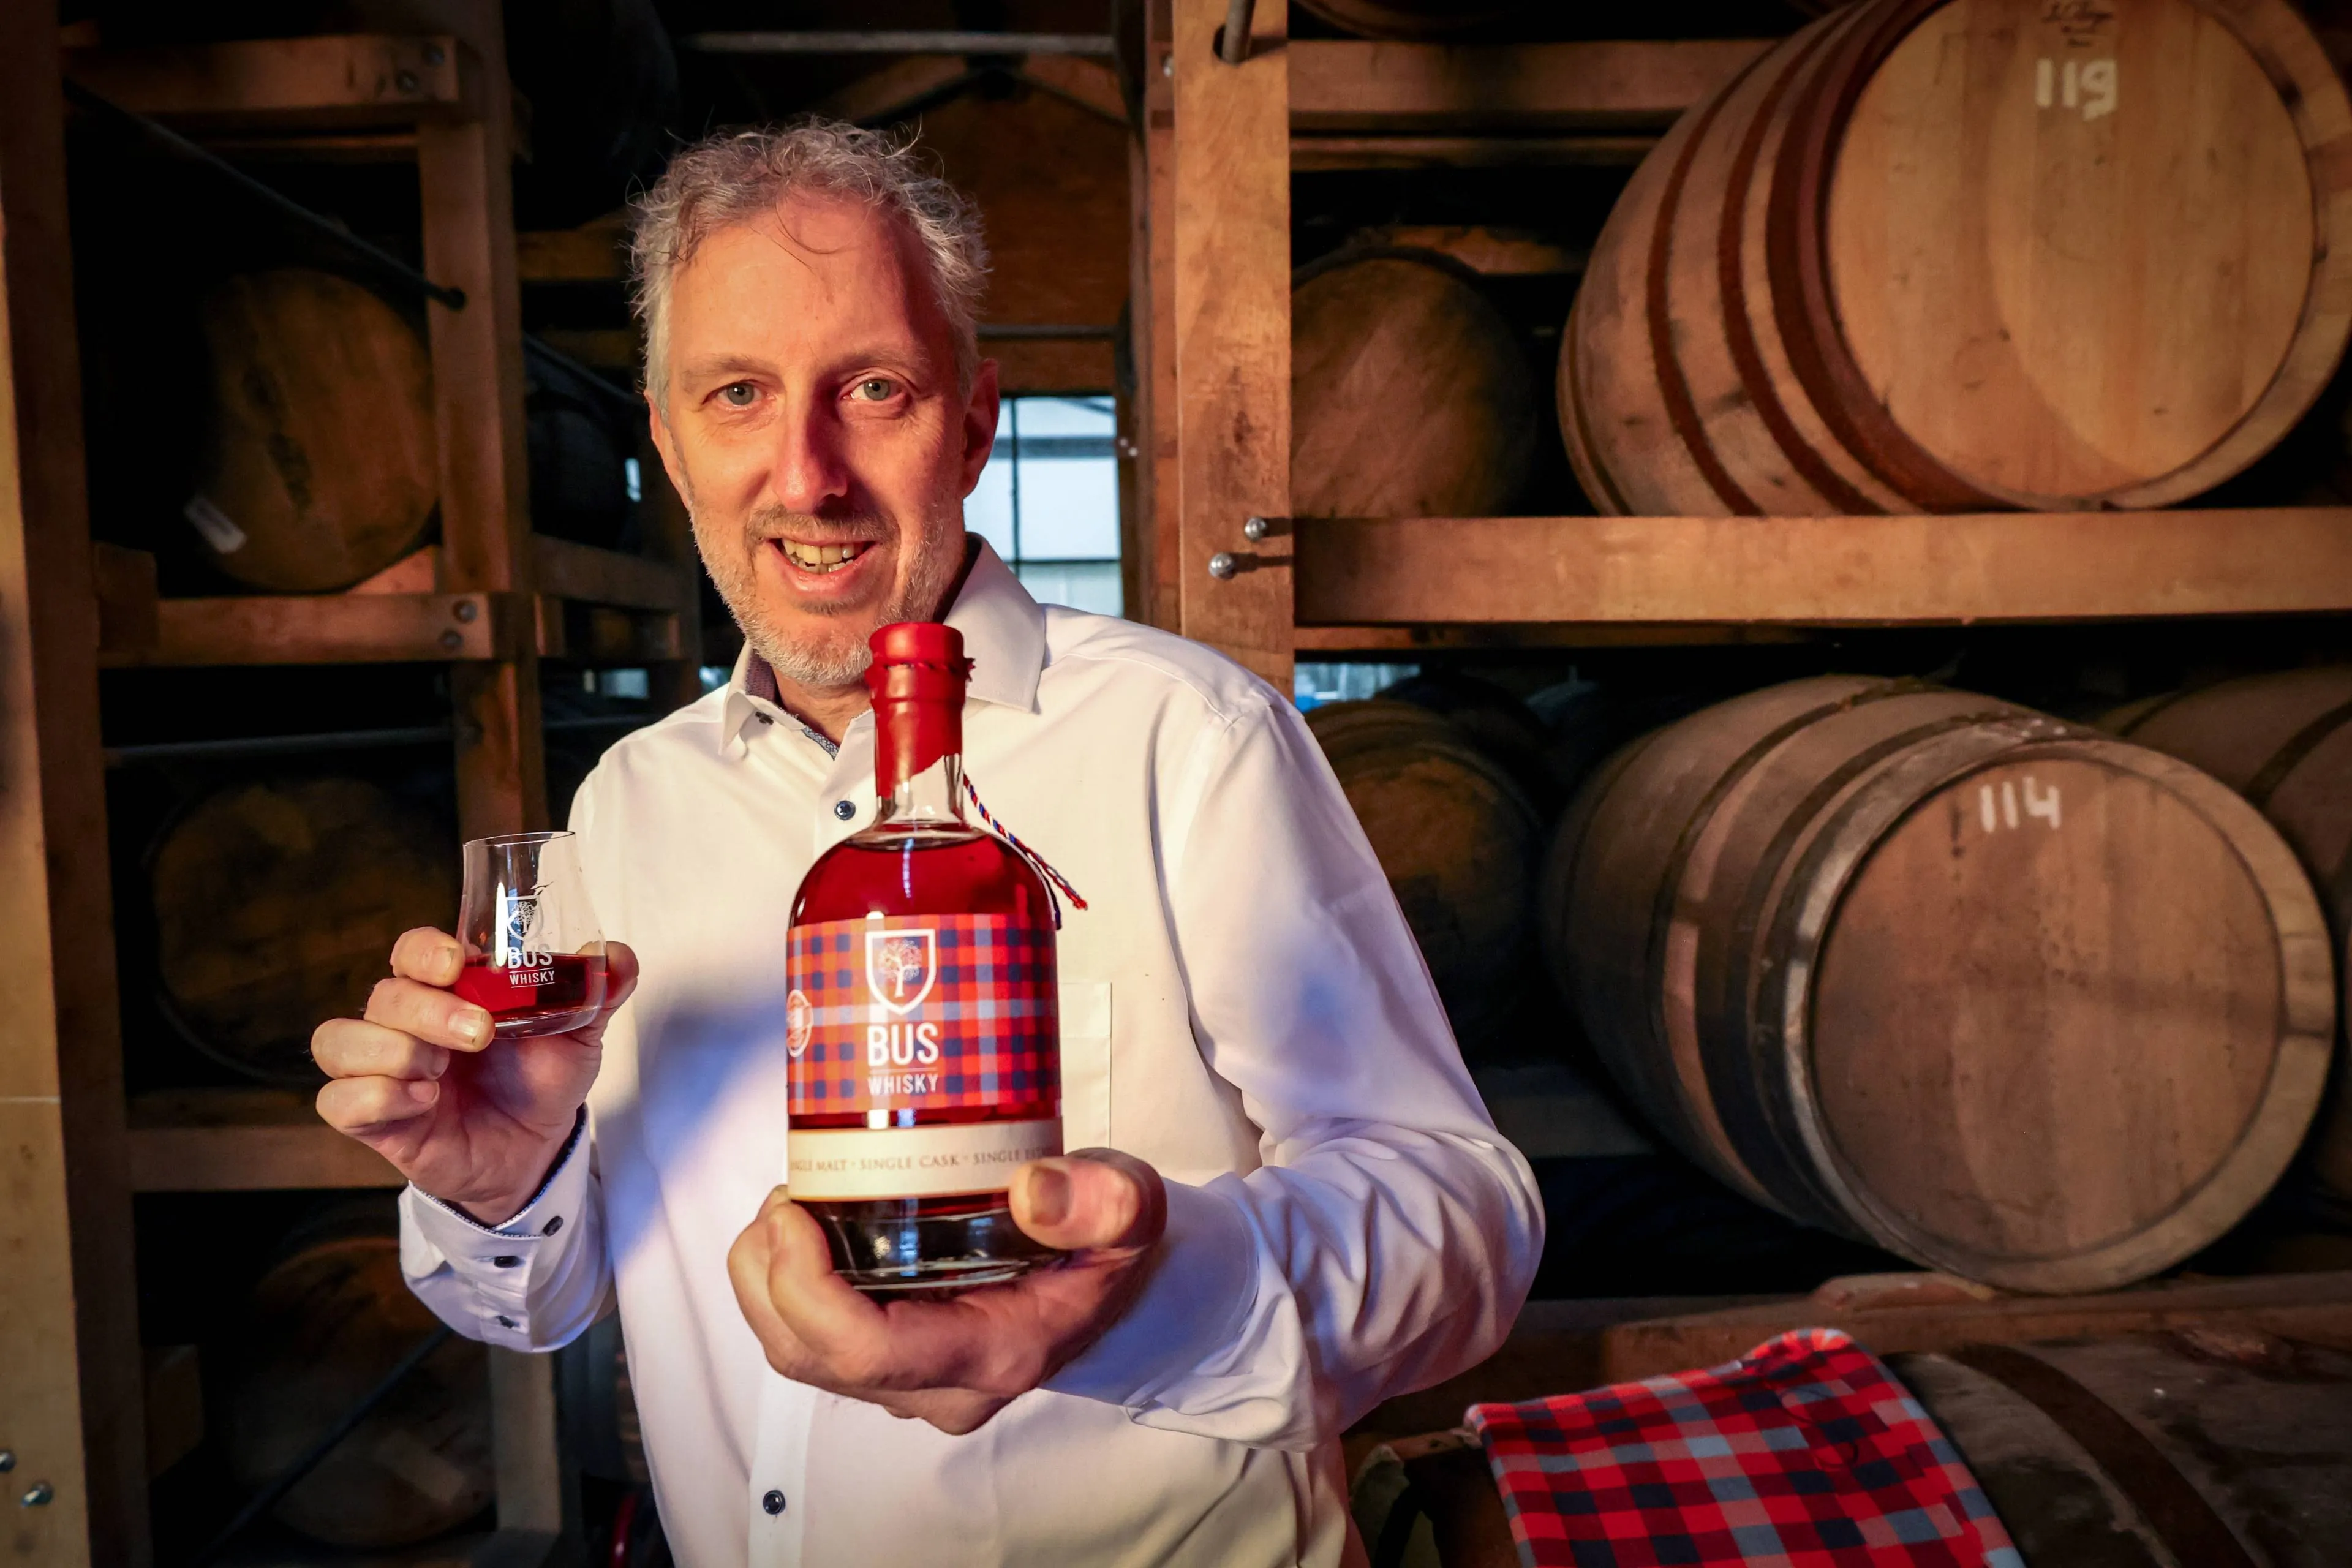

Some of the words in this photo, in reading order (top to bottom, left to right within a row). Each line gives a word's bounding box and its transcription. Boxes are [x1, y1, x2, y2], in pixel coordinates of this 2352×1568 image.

[2036, 59, 2118, 121] 119
[1979, 776, 2062, 833] 114
[507, 943, 553, 970] BUS
[509, 970, 555, 986] WHISKY
[867, 1022, 939, 1066] BUS
[867, 1073, 938, 1095] WHISKY
[816, 1158, 848, 1172] MALT
[860, 1155, 912, 1171] SINGLE
[919, 1153, 959, 1169] CASK
[973, 1148, 1020, 1165] SINGLE
